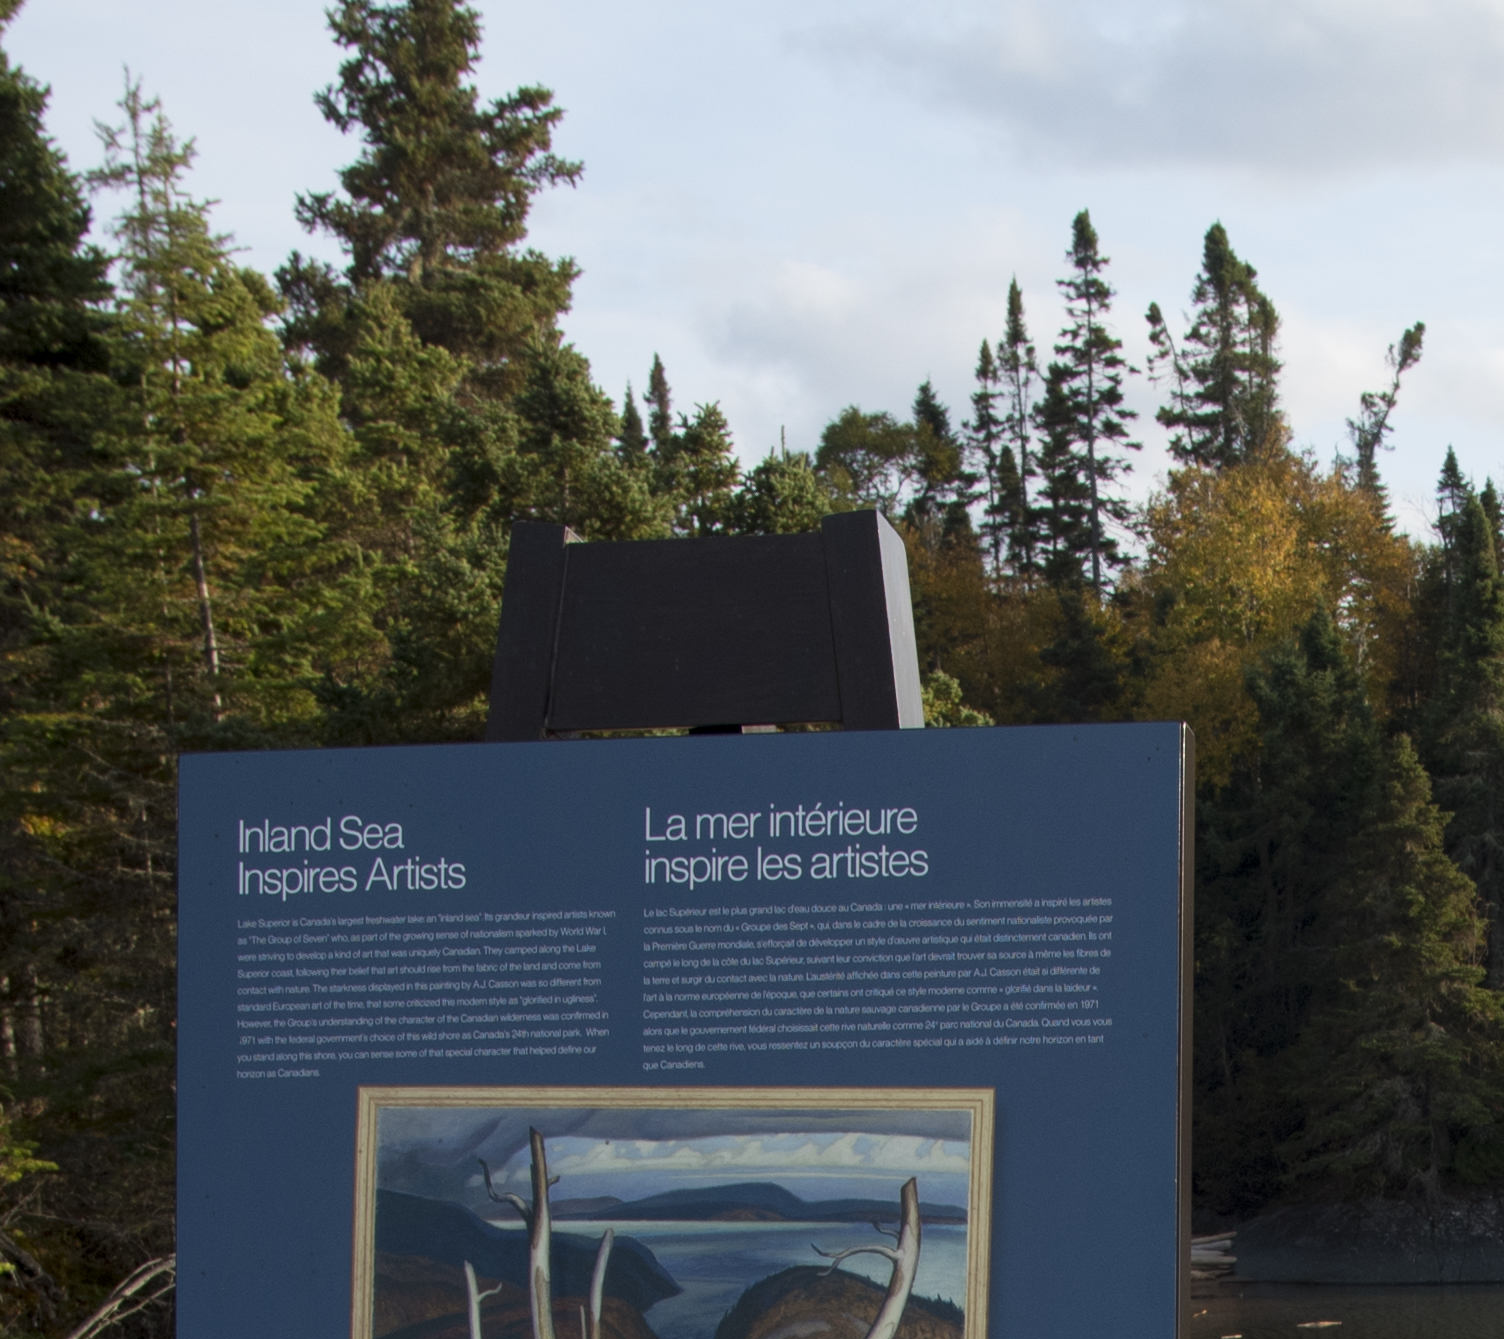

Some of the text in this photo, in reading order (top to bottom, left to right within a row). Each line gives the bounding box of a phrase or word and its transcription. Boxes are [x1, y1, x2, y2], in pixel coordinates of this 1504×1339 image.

[239, 815, 404, 853] Inland Sea
[646, 801, 917, 841] La mer intérieure
[239, 856, 466, 901] Inspires Artists
[645, 844, 928, 890] inspire les artistes
[237, 920, 256, 928] Lake
[258, 918, 290, 929] Superior
[291, 918, 298, 926] is
[337, 916, 363, 926] largest
[365, 915, 405, 923] freshwater
[484, 912, 493, 921] Its
[495, 912, 530, 922] grandeur
[531, 911, 562, 921] inspired
[563, 910, 587, 918] artists
[588, 909, 615, 918] known
[643, 1008, 688, 1020] Cependant,
[690, 1008, 697, 1017] la
[698, 1007, 760, 1018] compréhension
[761, 1007, 772, 1015] du
[773, 1006, 812, 1015] caractère
[813, 1006, 824, 1014] de
[825, 1005, 832, 1014] la
[834, 1005, 860, 1013] nature
[861, 1006, 896, 1015] sauvage
[897, 1003, 945, 1012] canadienne
[946, 1005, 960, 1013] par
[961, 1003, 969, 1011] le
[970, 1002, 1001, 1013] Groupe
[1010, 1001, 1023, 1010] été
[1024, 1001, 1065, 1009] confirmée
[1079, 1000, 1098, 1008] 1971
[236, 1069, 265, 1077] horizon
[643, 1059, 704, 1071] que Canadiens.
